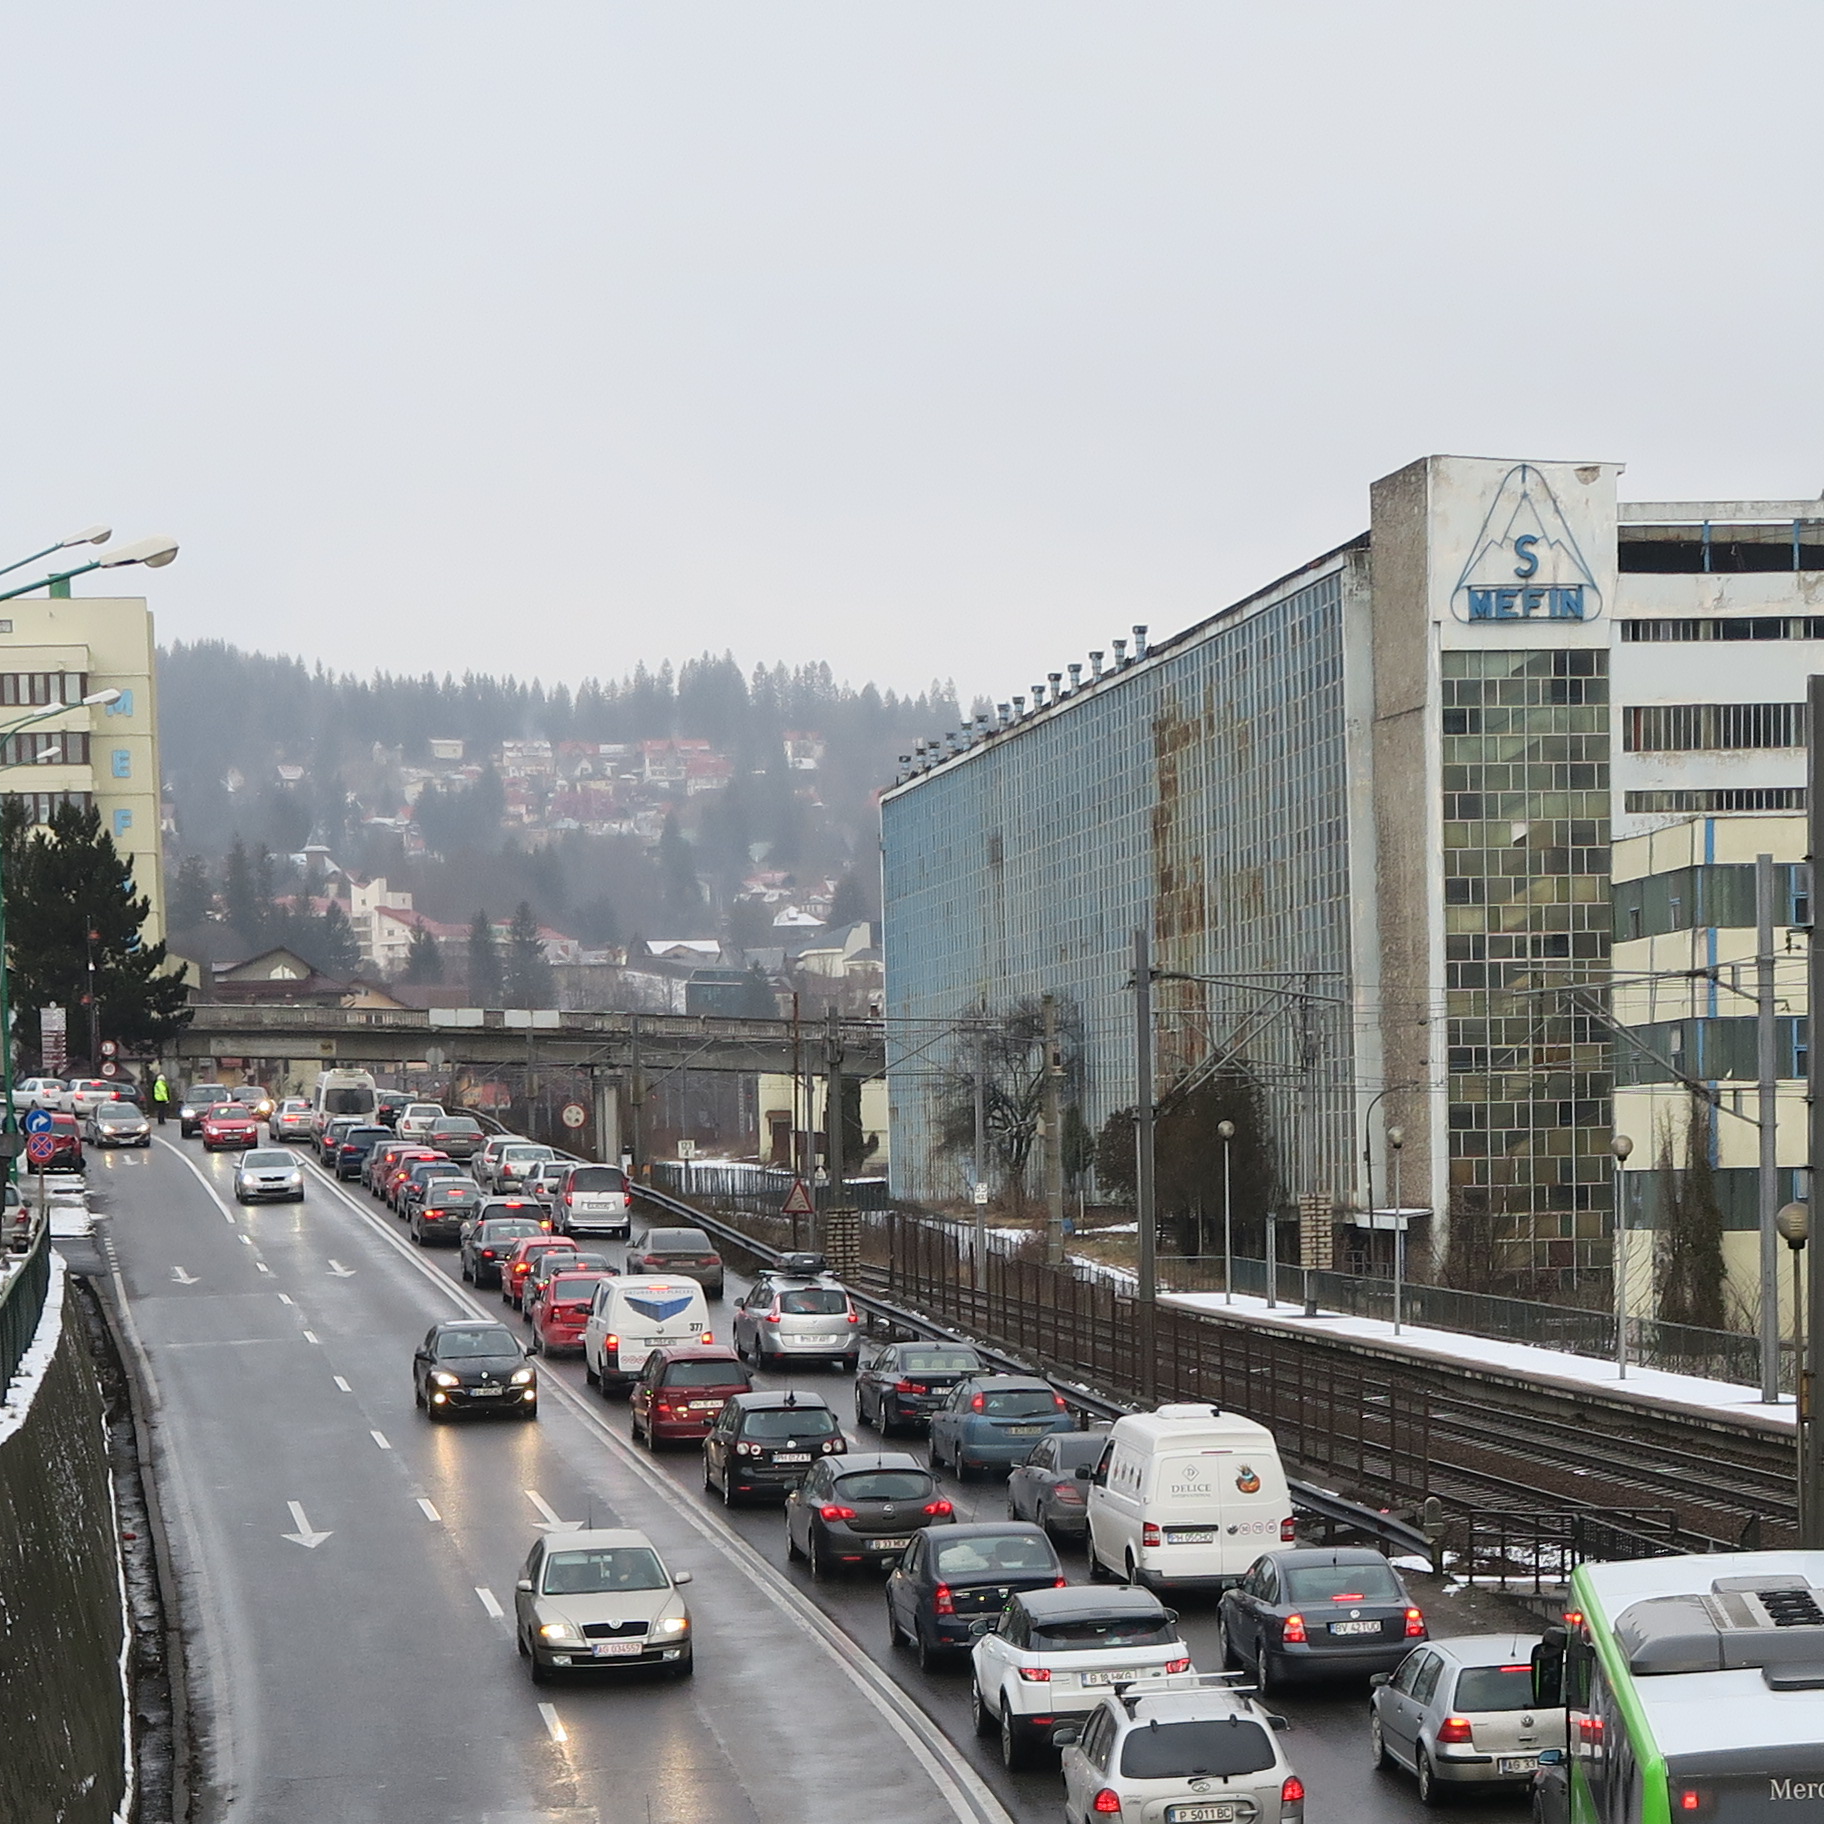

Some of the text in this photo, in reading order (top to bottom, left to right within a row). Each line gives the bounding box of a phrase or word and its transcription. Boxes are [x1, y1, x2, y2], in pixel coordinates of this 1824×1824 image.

[1514, 533, 1538, 579] S
[1469, 588, 1585, 620] MEFIN
[689, 1322, 703, 1331] 377
[1171, 1484, 1212, 1493] DELICE
